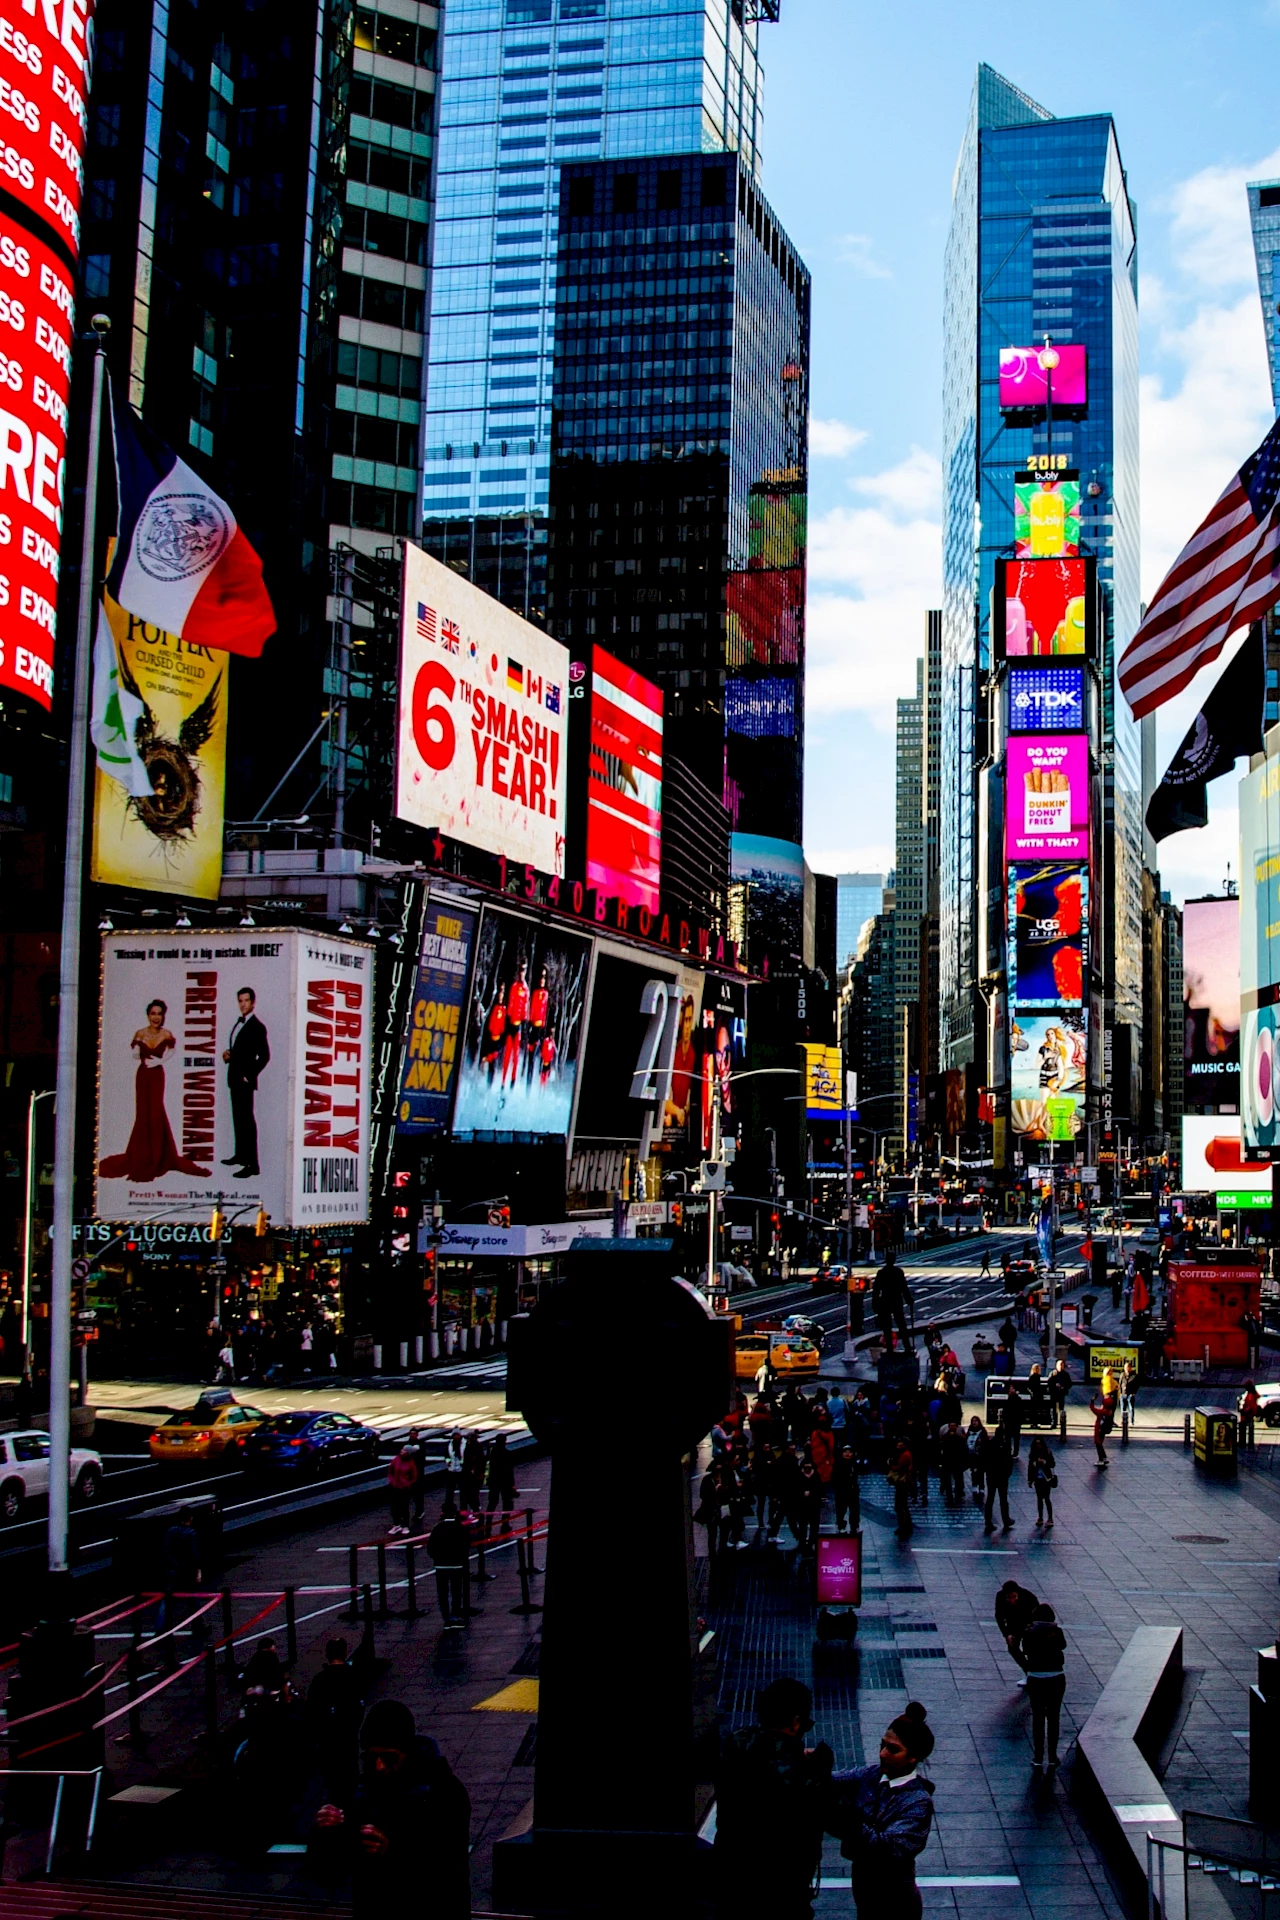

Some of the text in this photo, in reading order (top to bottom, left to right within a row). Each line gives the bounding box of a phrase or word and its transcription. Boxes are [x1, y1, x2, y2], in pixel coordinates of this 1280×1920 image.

[1026, 454, 1068, 471] 2018
[136, 650, 205, 679] CURSED CHILD
[1029, 691, 1077, 707] TDK
[472, 688, 548, 764] SMASH
[1027, 747, 1068, 757] DO YOU
[1031, 757, 1063, 766] WANT
[1029, 809, 1062, 817] DONUT
[1016, 837, 1079, 848] WITH THAT?
[1036, 919, 1060, 931] UGG
[184, 971, 218, 1054] PRETTY
[414, 999, 460, 1034] COME
[303, 979, 335, 1147] WOMAN
[332, 979, 363, 1155] PRETTY
[404, 1059, 453, 1092] AWAY
[1191, 1063, 1224, 1073] MUSIC
[182, 1069, 216, 1162] WOMAN
[303, 1157, 359, 1194] THE MUSICAL
[440, 1229, 508, 1250] Disney store
